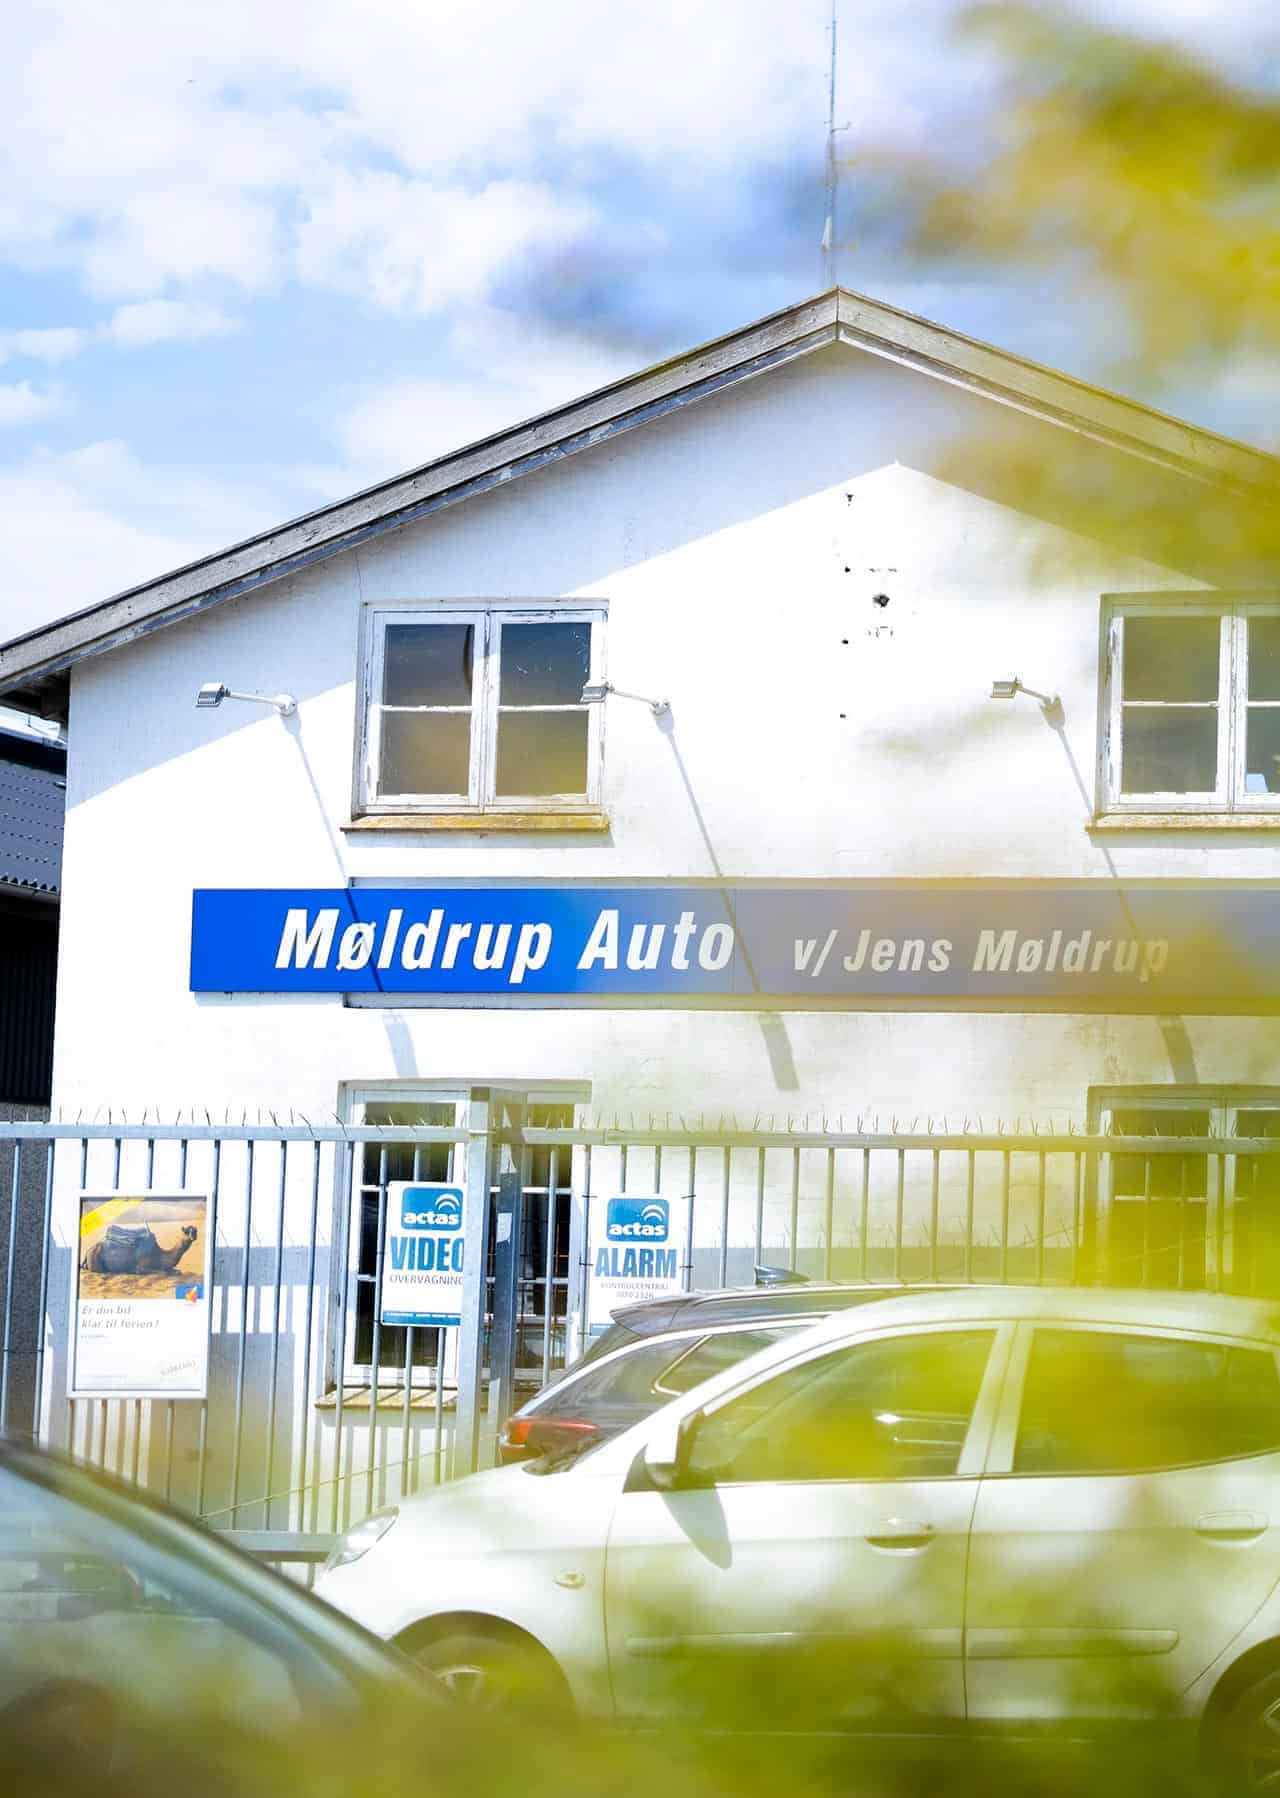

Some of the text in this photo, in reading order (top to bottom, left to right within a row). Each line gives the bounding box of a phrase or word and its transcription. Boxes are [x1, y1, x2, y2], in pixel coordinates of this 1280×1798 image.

[274, 908, 1169, 984] Møldrup Auto v/ Jens Møldrup
[403, 1211, 460, 1226] actas
[608, 1222, 665, 1237] actas
[594, 1247, 678, 1279] ALARM
